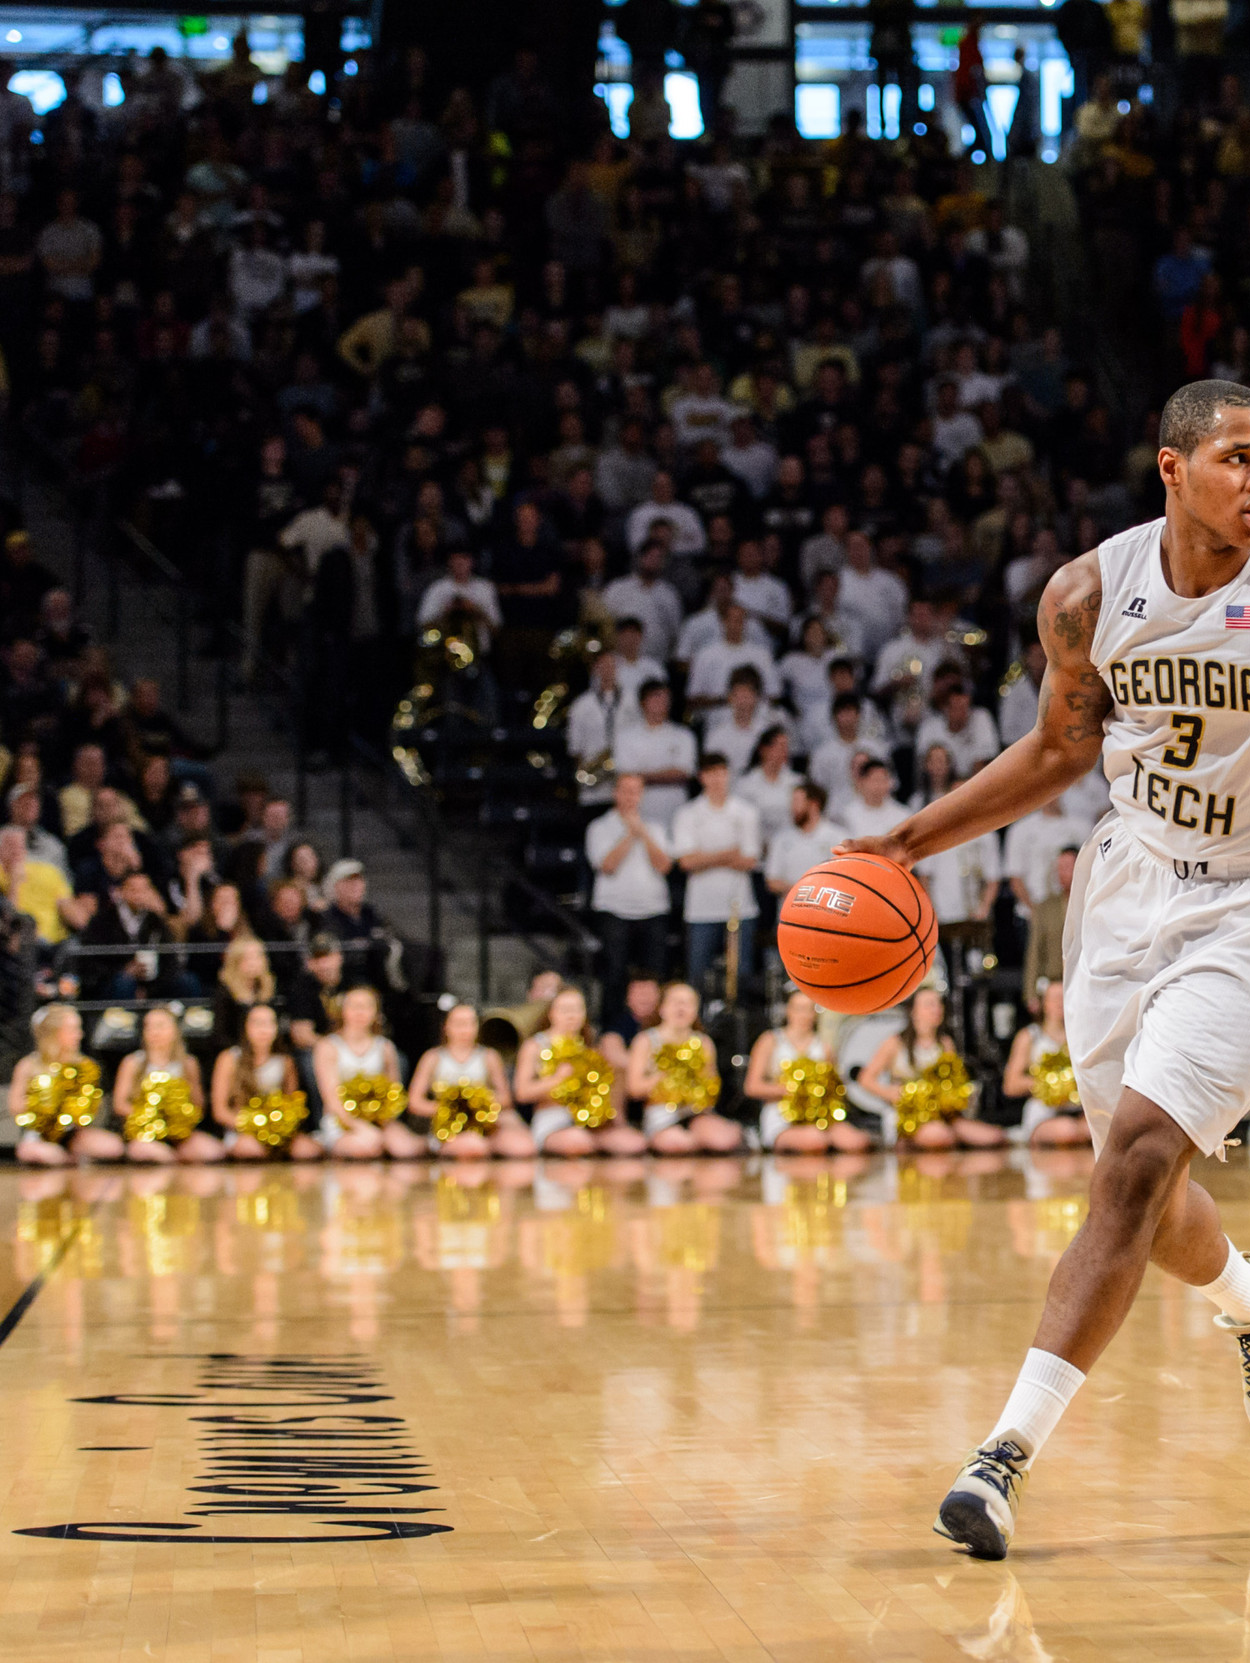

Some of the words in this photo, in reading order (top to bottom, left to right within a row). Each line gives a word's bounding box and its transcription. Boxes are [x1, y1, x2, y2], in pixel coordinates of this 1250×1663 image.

[1161, 712, 1206, 771] 3
[1131, 753, 1236, 837] TECH
[793, 885, 856, 914] ELITE
